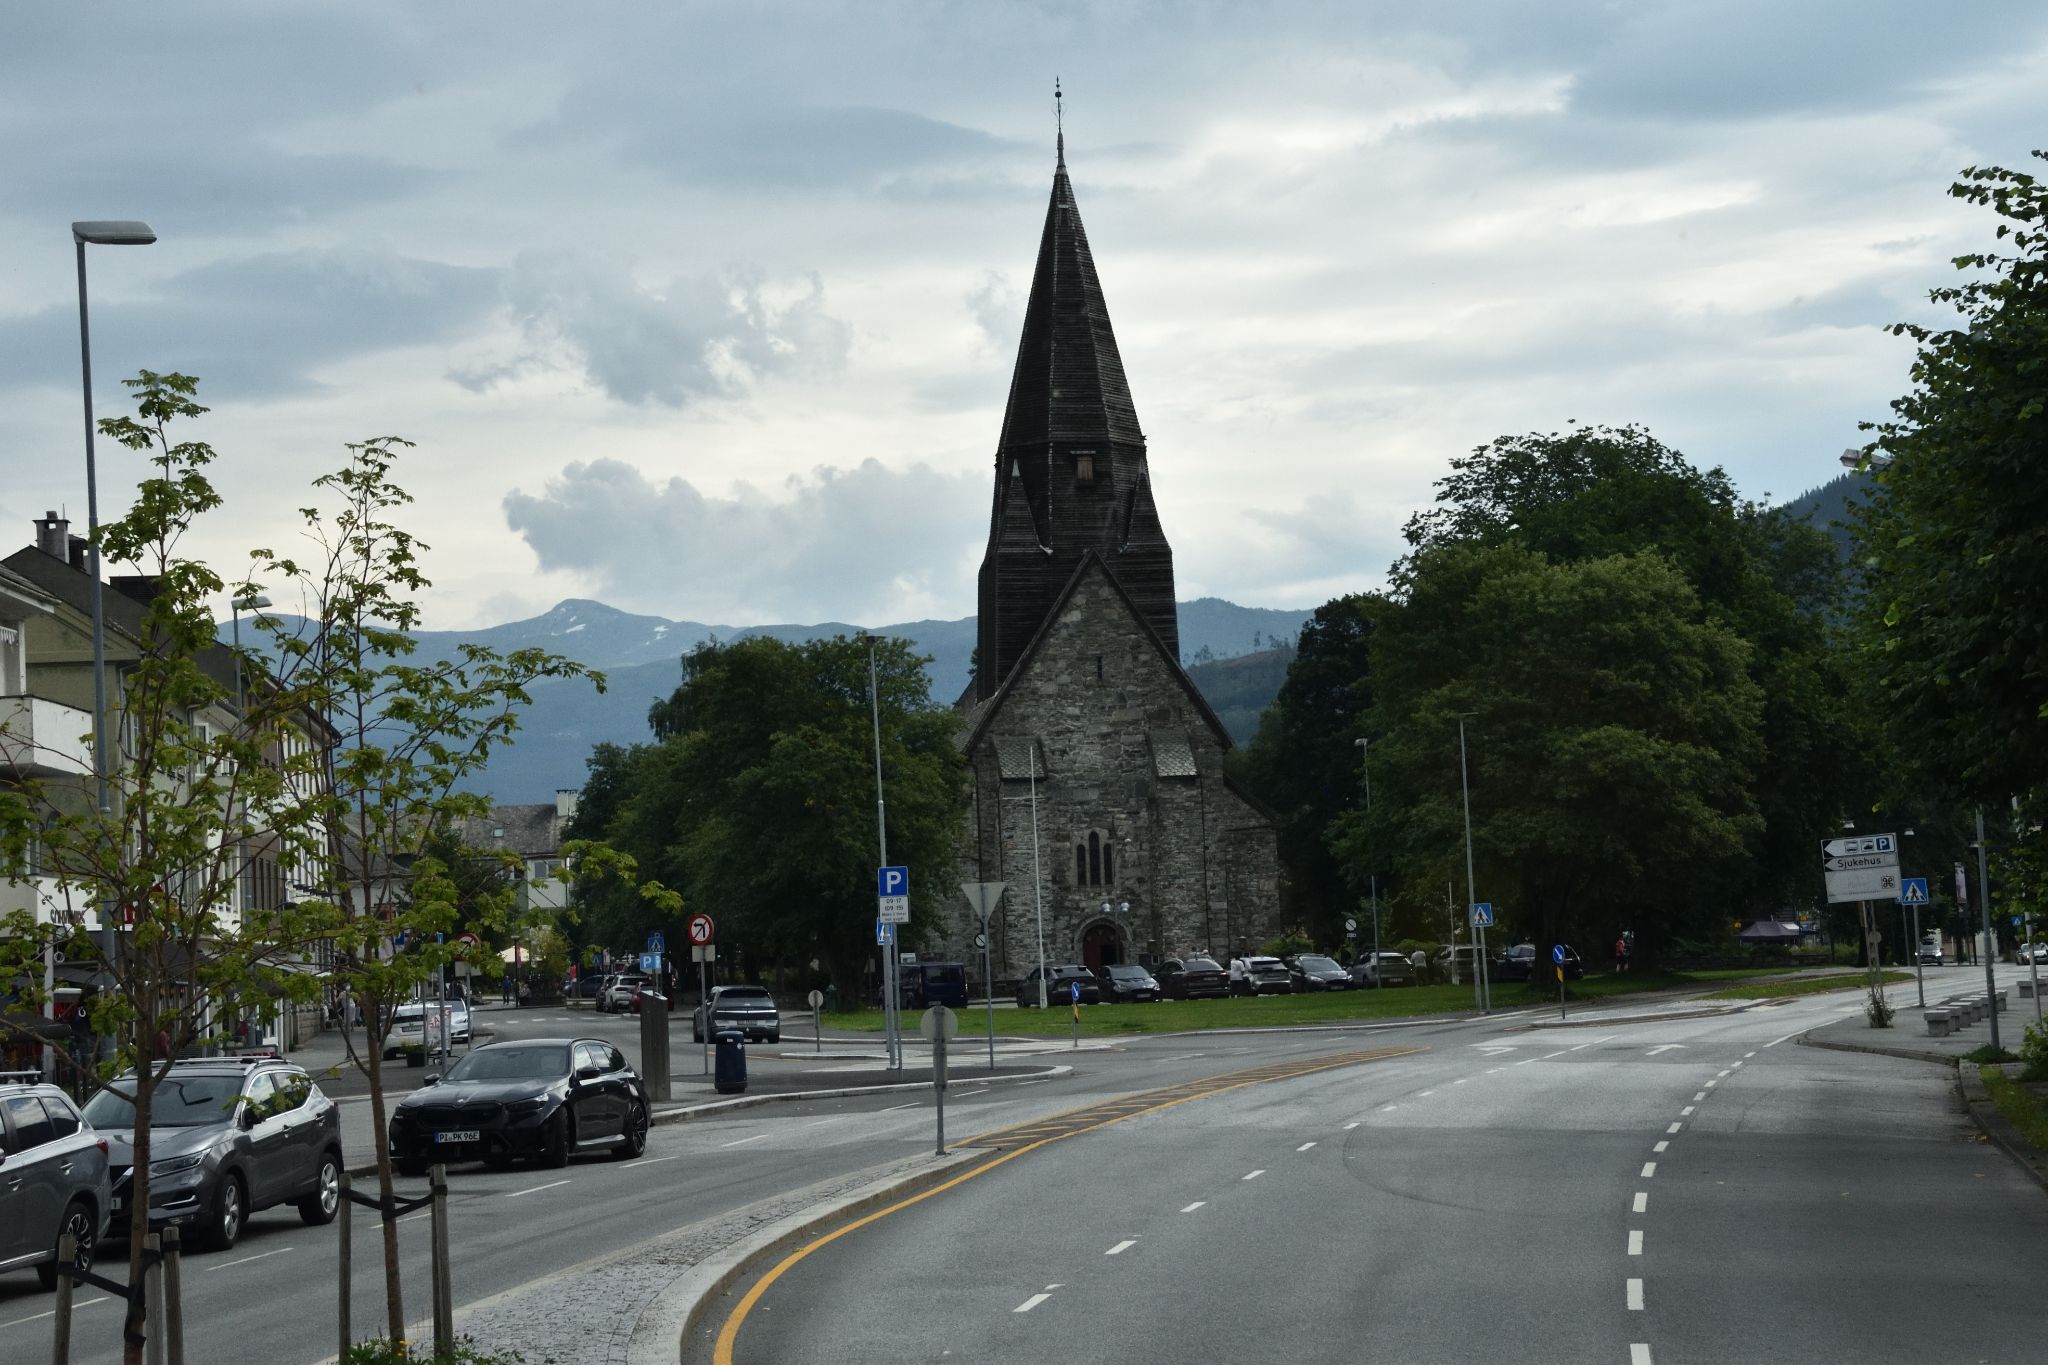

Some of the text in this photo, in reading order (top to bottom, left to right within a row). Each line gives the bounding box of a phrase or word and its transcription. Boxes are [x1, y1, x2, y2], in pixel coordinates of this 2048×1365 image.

[1879, 838, 1887, 849] P
[1837, 857, 1881, 868] Sjukehus
[886, 871, 902, 894] P
[643, 956, 652, 968] P
